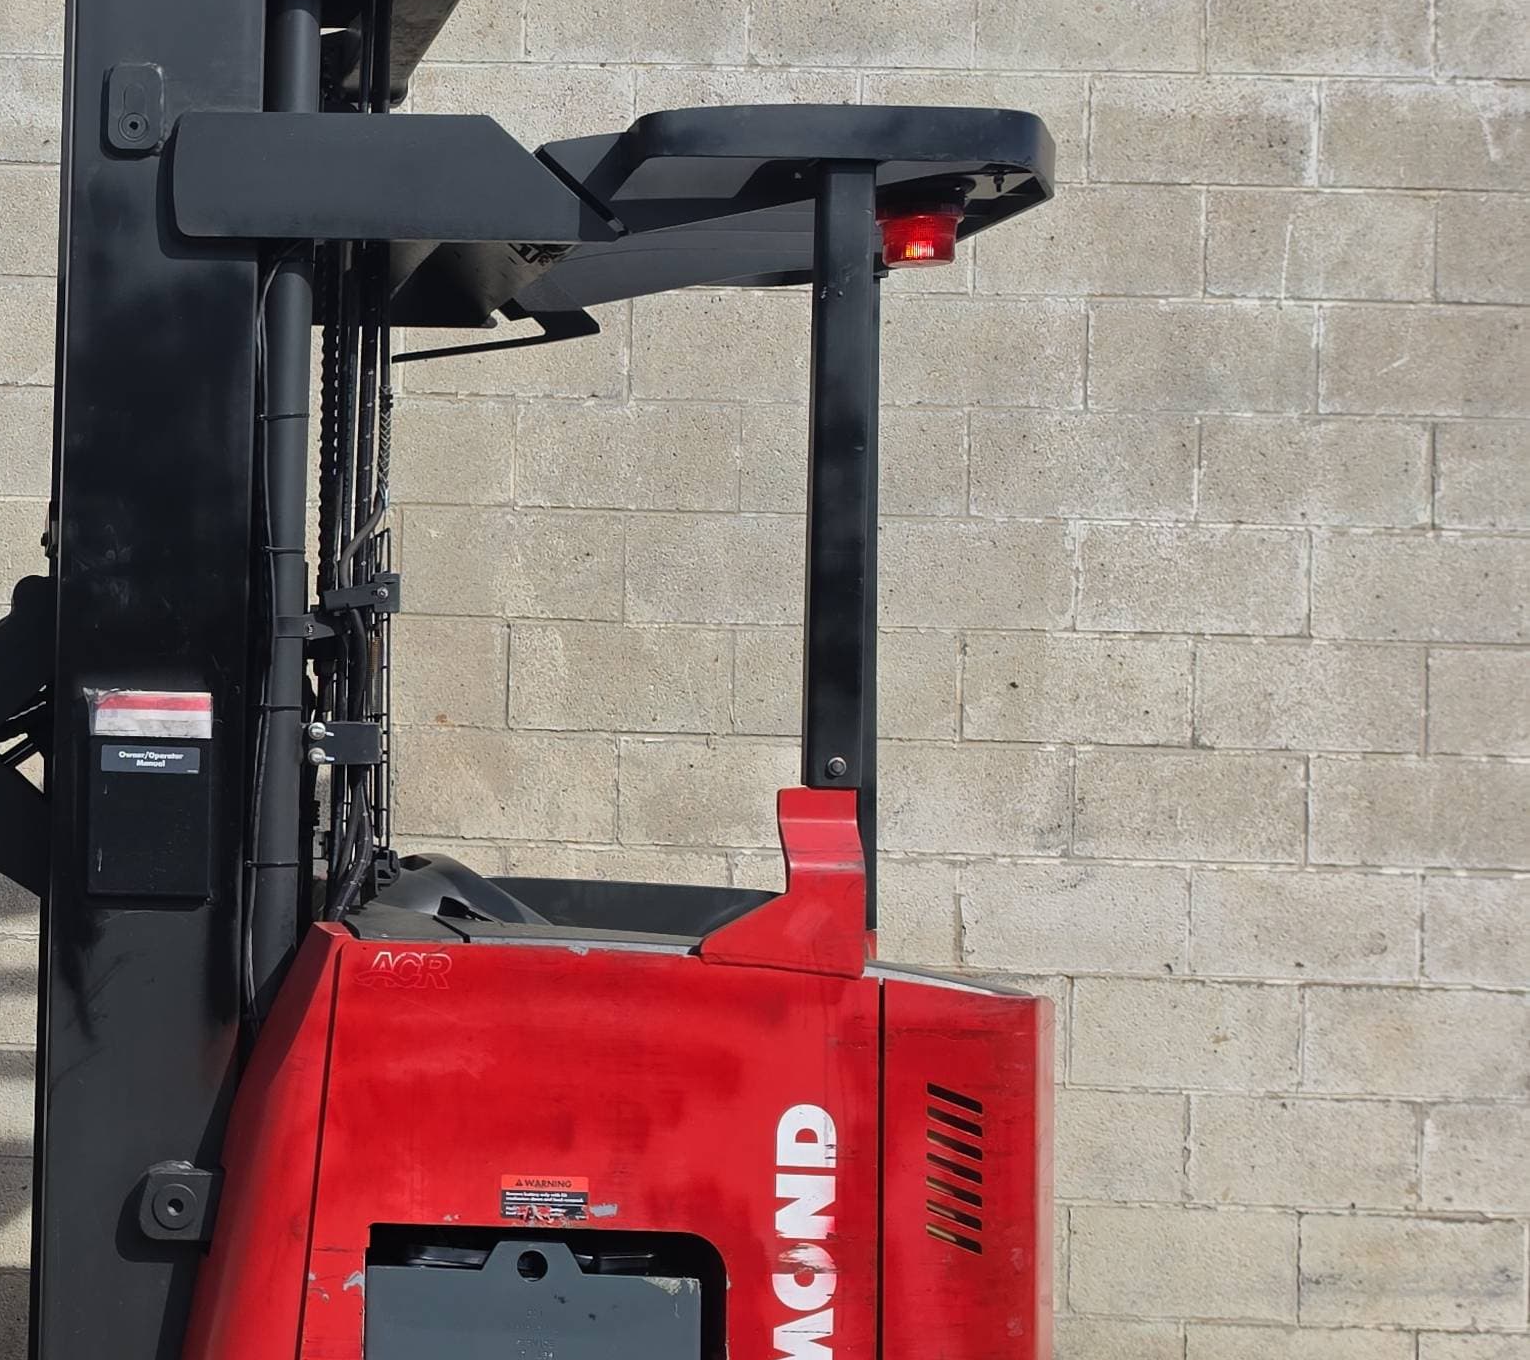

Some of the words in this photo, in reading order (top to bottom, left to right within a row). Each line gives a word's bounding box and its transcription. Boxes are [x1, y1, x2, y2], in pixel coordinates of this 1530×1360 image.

[118, 751, 184, 760] Owner/Operator
[136, 759, 166, 767] Manual
[369, 951, 452, 989] ACR
[525, 1180, 572, 1188] WARNING
